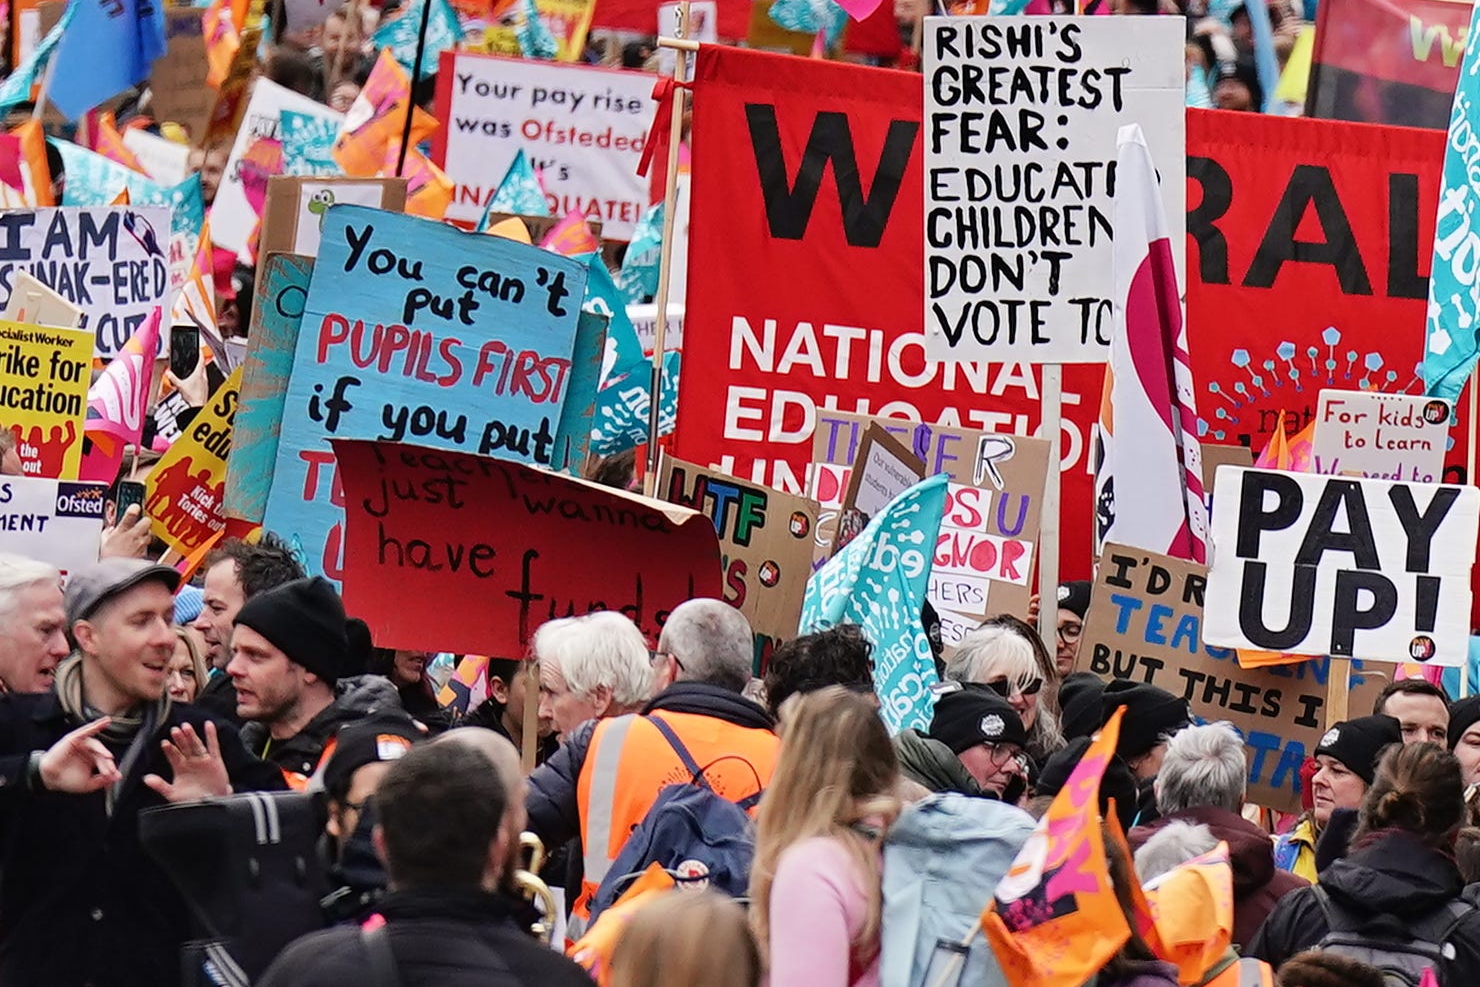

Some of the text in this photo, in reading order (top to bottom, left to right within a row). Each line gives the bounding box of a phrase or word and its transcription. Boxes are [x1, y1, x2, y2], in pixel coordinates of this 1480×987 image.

[936, 21, 1082, 63] RISHI'S
[457, 73, 643, 114] Your pay rise
[932, 64, 1132, 112] GREATEST
[455, 116, 646, 153] was Ofsteded
[745, 103, 1429, 300] WRAL
[930, 161, 1118, 203] EDUCAT
[0, 210, 120, 261] I AM
[927, 205, 1114, 250] CHILDREN
[345, 223, 569, 317] You can't
[929, 250, 1073, 298] DON'T
[403, 287, 481, 325] put
[932, 298, 1112, 348] VOTE TO
[0, 330, 75, 348] ocialist Worker
[317, 313, 572, 405] PUPILS FIRST
[0, 344, 87, 384] rike for
[0, 382, 82, 417] ucation
[308, 376, 554, 464] if you put
[1324, 400, 1426, 429] For kids
[20, 443, 38, 458] the
[1344, 430, 1432, 451] to learn
[22, 459, 42, 474] out
[1412, 464, 1433, 483] to
[57, 496, 104, 514] Ofsted
[178, 494, 209, 527] Tories
[190, 485, 217, 508] Kick
[362, 476, 672, 535] just wanna
[1236, 470, 1461, 574] PAY
[378, 521, 498, 579] have
[1105, 554, 1171, 596] I'D
[1238, 560, 1442, 657] UP!
[1090, 644, 1163, 685] BUT
[1178, 667, 1282, 718] THIS
